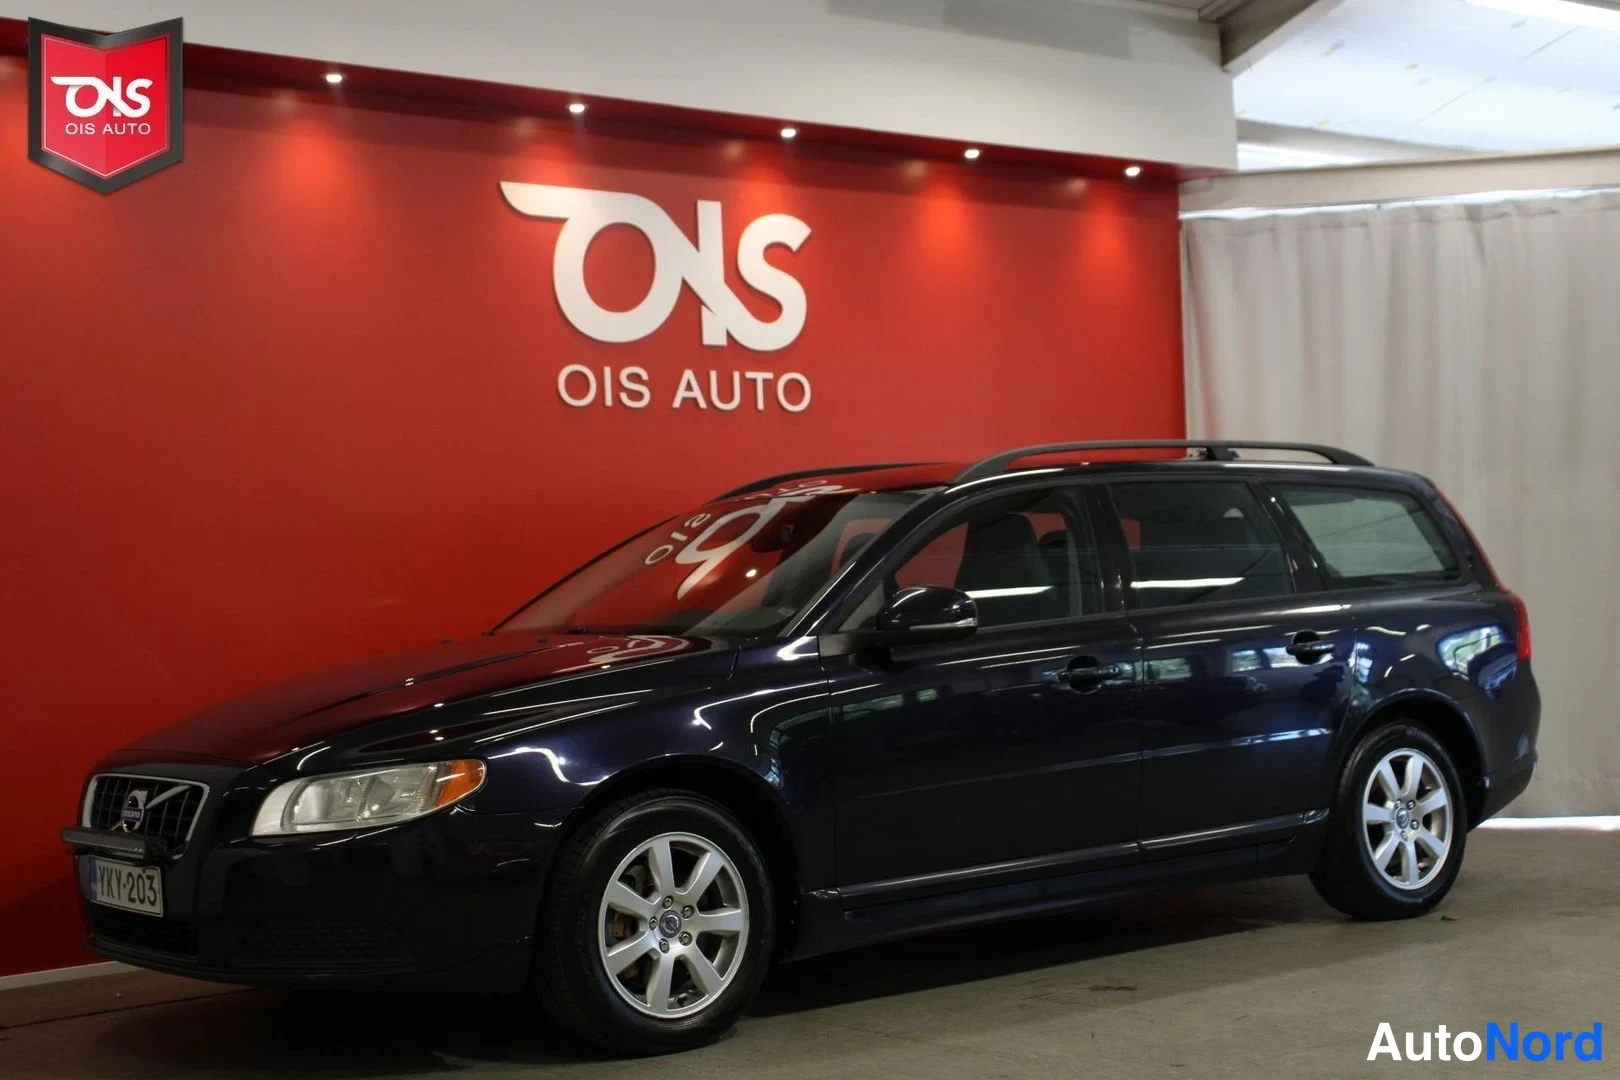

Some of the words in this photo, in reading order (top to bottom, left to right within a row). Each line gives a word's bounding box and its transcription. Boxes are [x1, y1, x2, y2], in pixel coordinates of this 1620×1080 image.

[557, 364, 651, 409] OIS
[672, 369, 812, 412] AUTO
[98, 864, 158, 907] YKY-203
